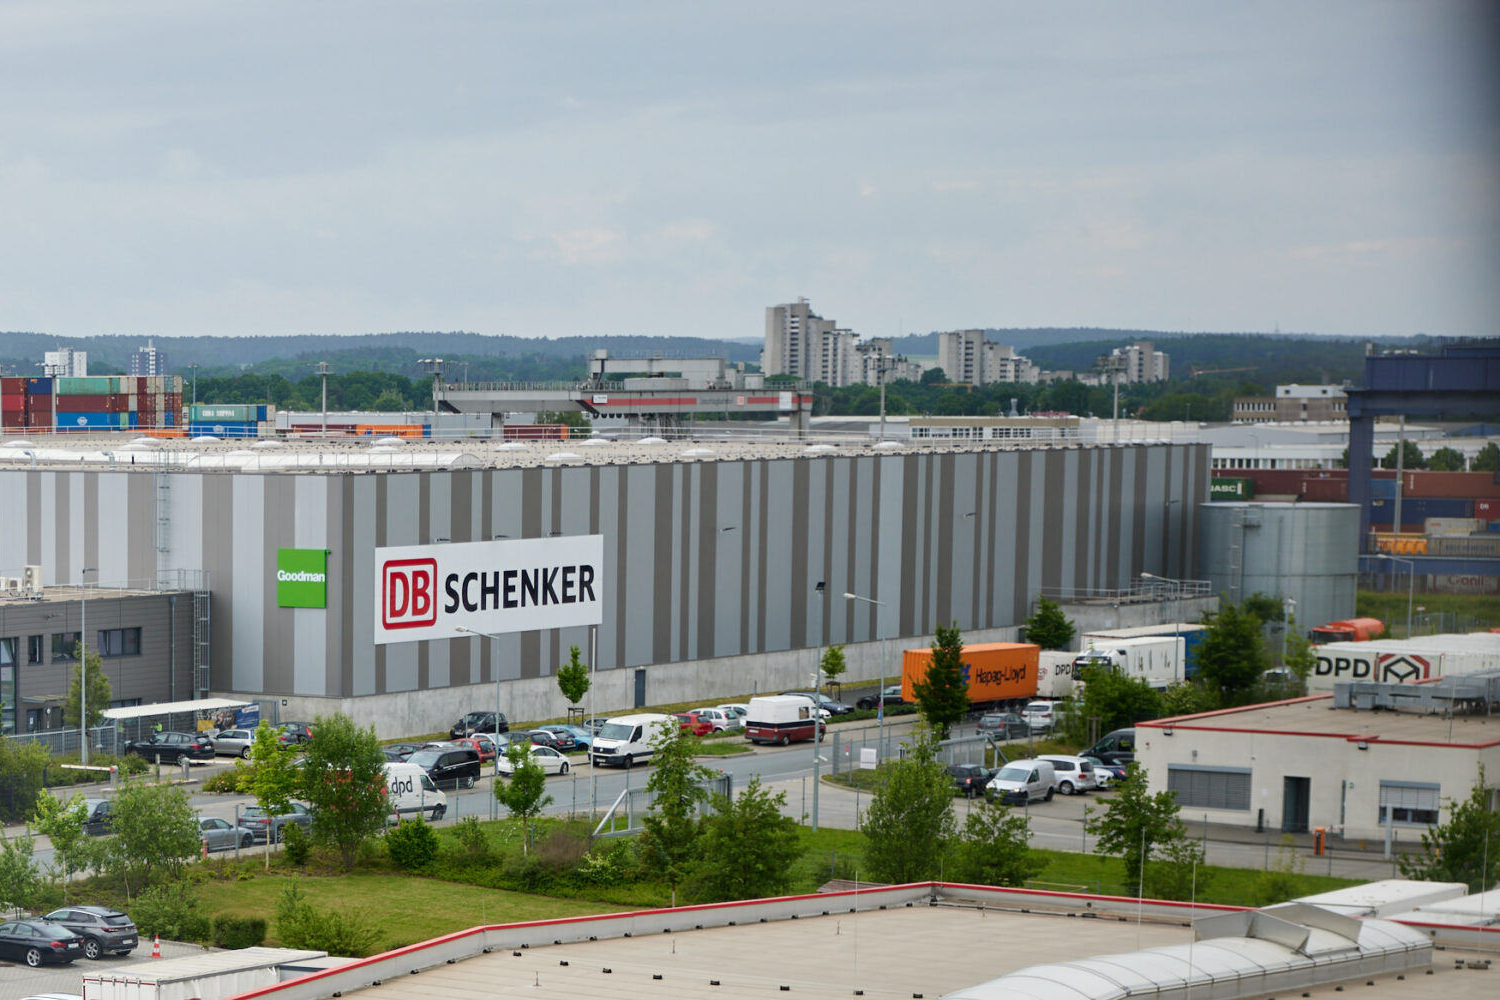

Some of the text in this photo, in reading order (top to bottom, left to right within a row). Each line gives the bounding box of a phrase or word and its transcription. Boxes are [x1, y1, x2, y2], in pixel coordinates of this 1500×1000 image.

[276, 568, 326, 583] Goodman
[389, 564, 597, 619] DB SCHENKER
[975, 664, 1027, 686] Hapag-Lloyd
[1315, 656, 1371, 678] DPD
[391, 775, 413, 798] dpd
